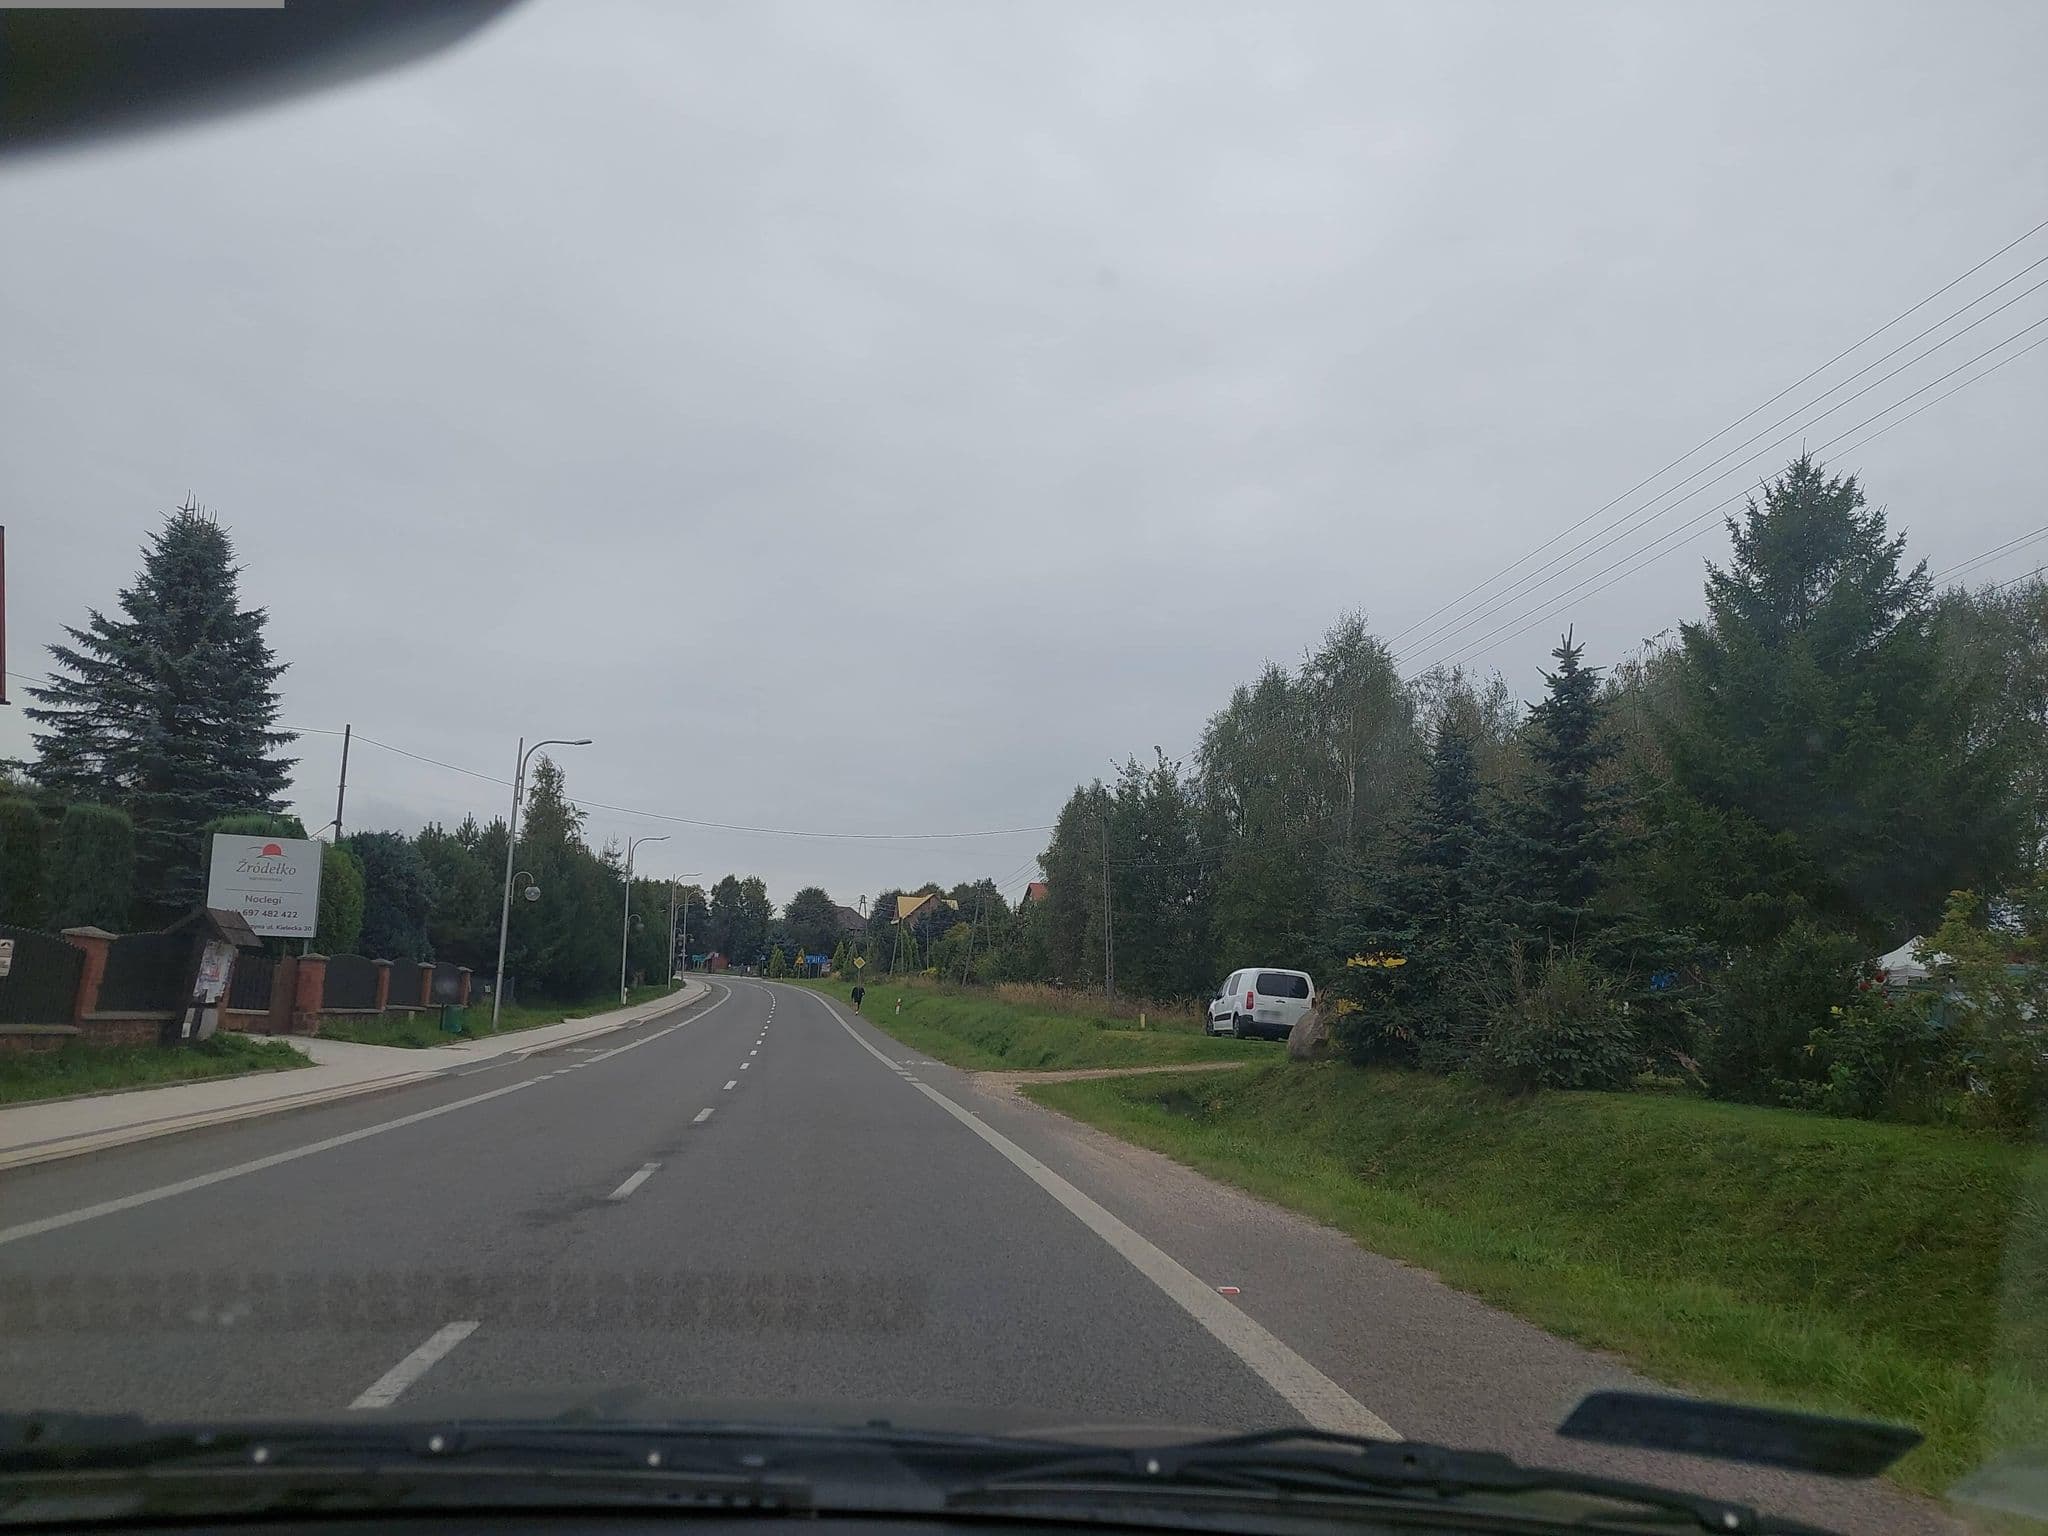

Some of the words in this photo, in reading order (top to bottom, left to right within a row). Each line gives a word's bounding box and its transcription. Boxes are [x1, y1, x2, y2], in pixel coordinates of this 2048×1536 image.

[245, 894, 282, 906] Noclegi
[242, 908, 260, 917] 697
[261, 909, 279, 918] 482
[280, 911, 299, 919] 422
